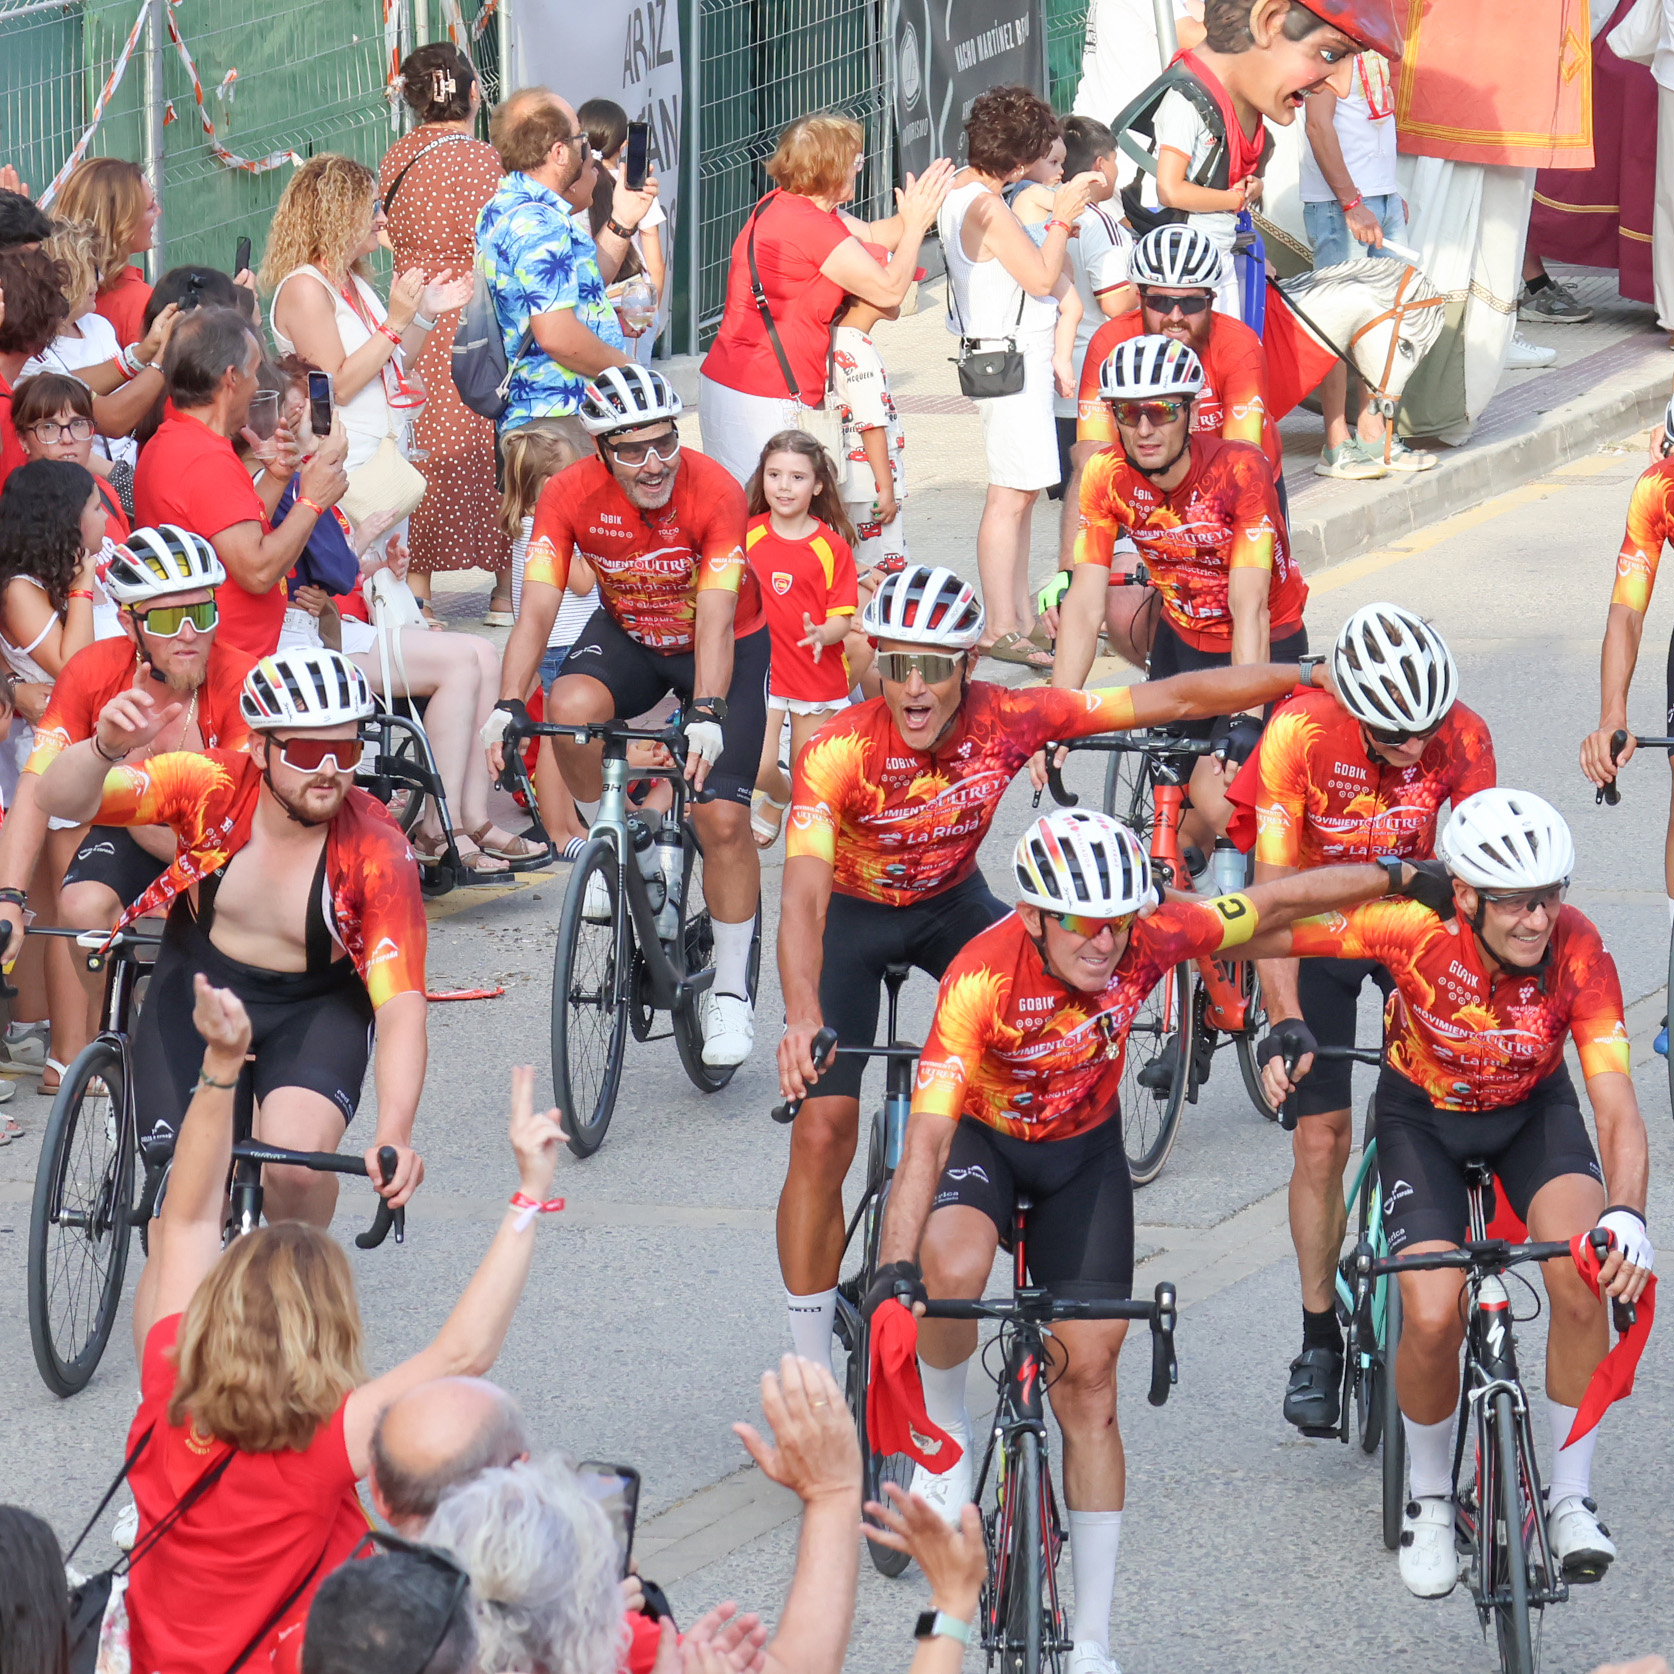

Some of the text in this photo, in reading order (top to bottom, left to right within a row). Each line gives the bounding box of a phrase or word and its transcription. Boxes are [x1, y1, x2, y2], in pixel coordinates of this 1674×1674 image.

[977, 20, 1014, 61] MARTÍNEZ
[846, 371, 874, 383] MCQUEEN
[886, 757, 918, 769] GOBIK
[1334, 761, 1367, 780] GOBIK
[602, 784, 621, 792] BH
[907, 811, 979, 844] La Rioja
[1308, 812, 1428, 831] MOVIMIENTO ULTREY
[1350, 841, 1413, 856] La Rioja
[1217, 898, 1246, 920] C
[1019, 996, 1055, 1011] GOBIK
[1413, 1003, 1484, 1042] MOVIMIENTO
[1460, 1055, 1480, 1066] La
[922, 1067, 962, 1082] ULTREYA
